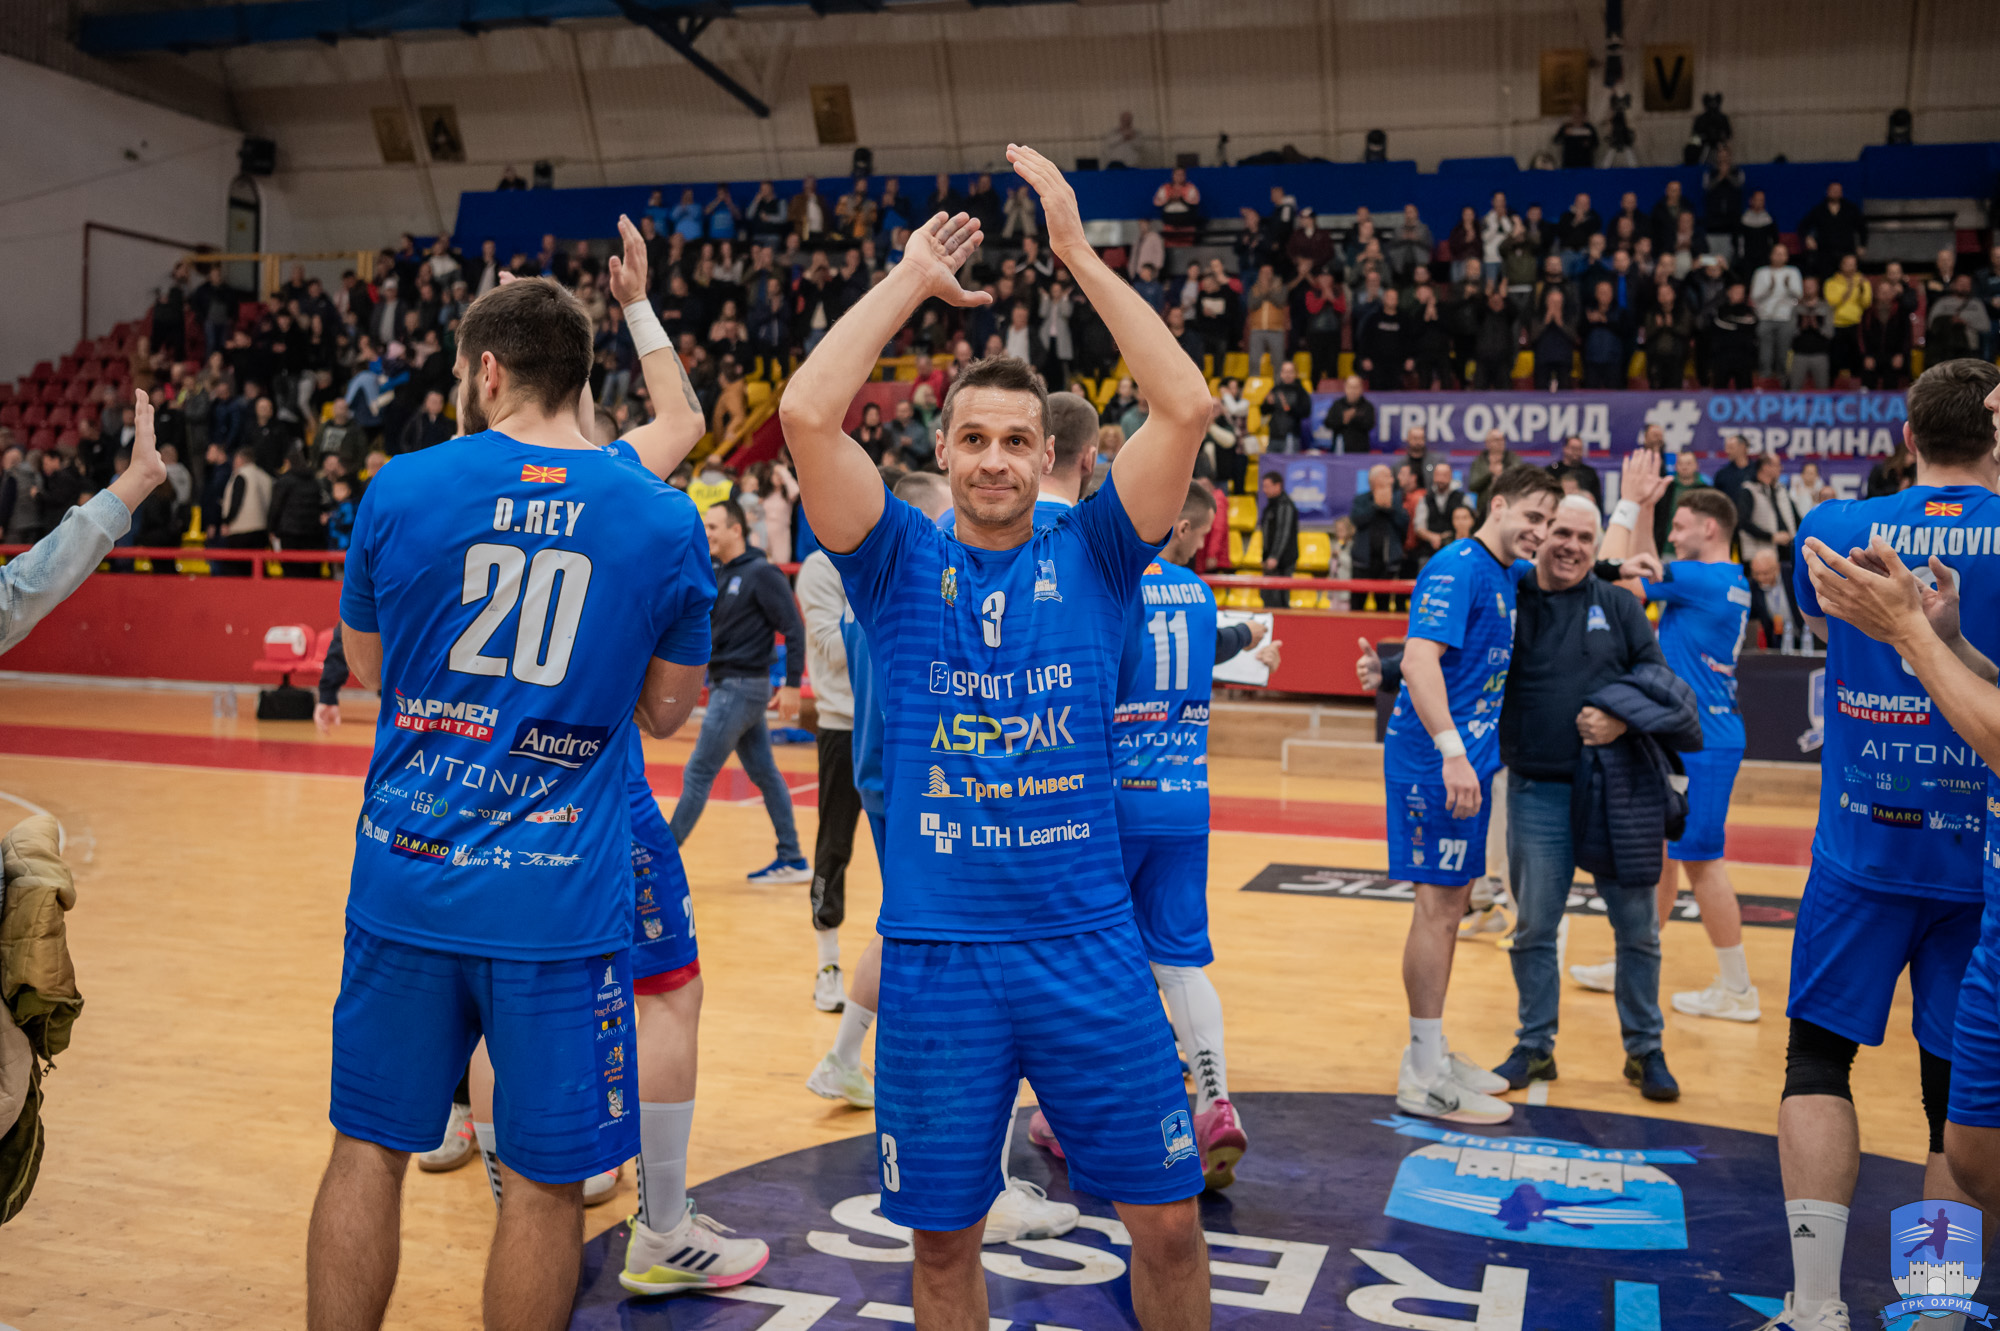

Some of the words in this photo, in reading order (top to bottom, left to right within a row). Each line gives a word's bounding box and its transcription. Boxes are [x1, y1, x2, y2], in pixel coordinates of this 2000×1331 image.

[1708, 395, 1908, 426] ОХРИДСКА
[1378, 403, 1457, 442] ГРК
[1463, 403, 1611, 450] ОХРИД
[448, 542, 593, 688] 20
[981, 589, 1006, 648] 3
[1147, 610, 1190, 692] 11
[1845, 690, 1931, 713] КАРМЕН
[520, 726, 600, 757] Andros
[1861, 739, 1989, 768] AITONI
[405, 749, 558, 798] AITONIX
[961, 777, 1013, 802] Трпе
[1019, 773, 1085, 798] Инвест
[1876, 772, 1892, 781] ICS
[1876, 781, 1892, 791] LED
[411, 801, 431, 815] LED
[414, 789, 435, 803] ICS
[1872, 807, 1922, 822] TAMARO
[396, 834, 450, 856] TAMARO
[972, 826, 1011, 847] LTH
[1019, 819, 1091, 847] Learnica
[1438, 838, 1468, 872] 27
[881, 1132, 901, 1193] 3
